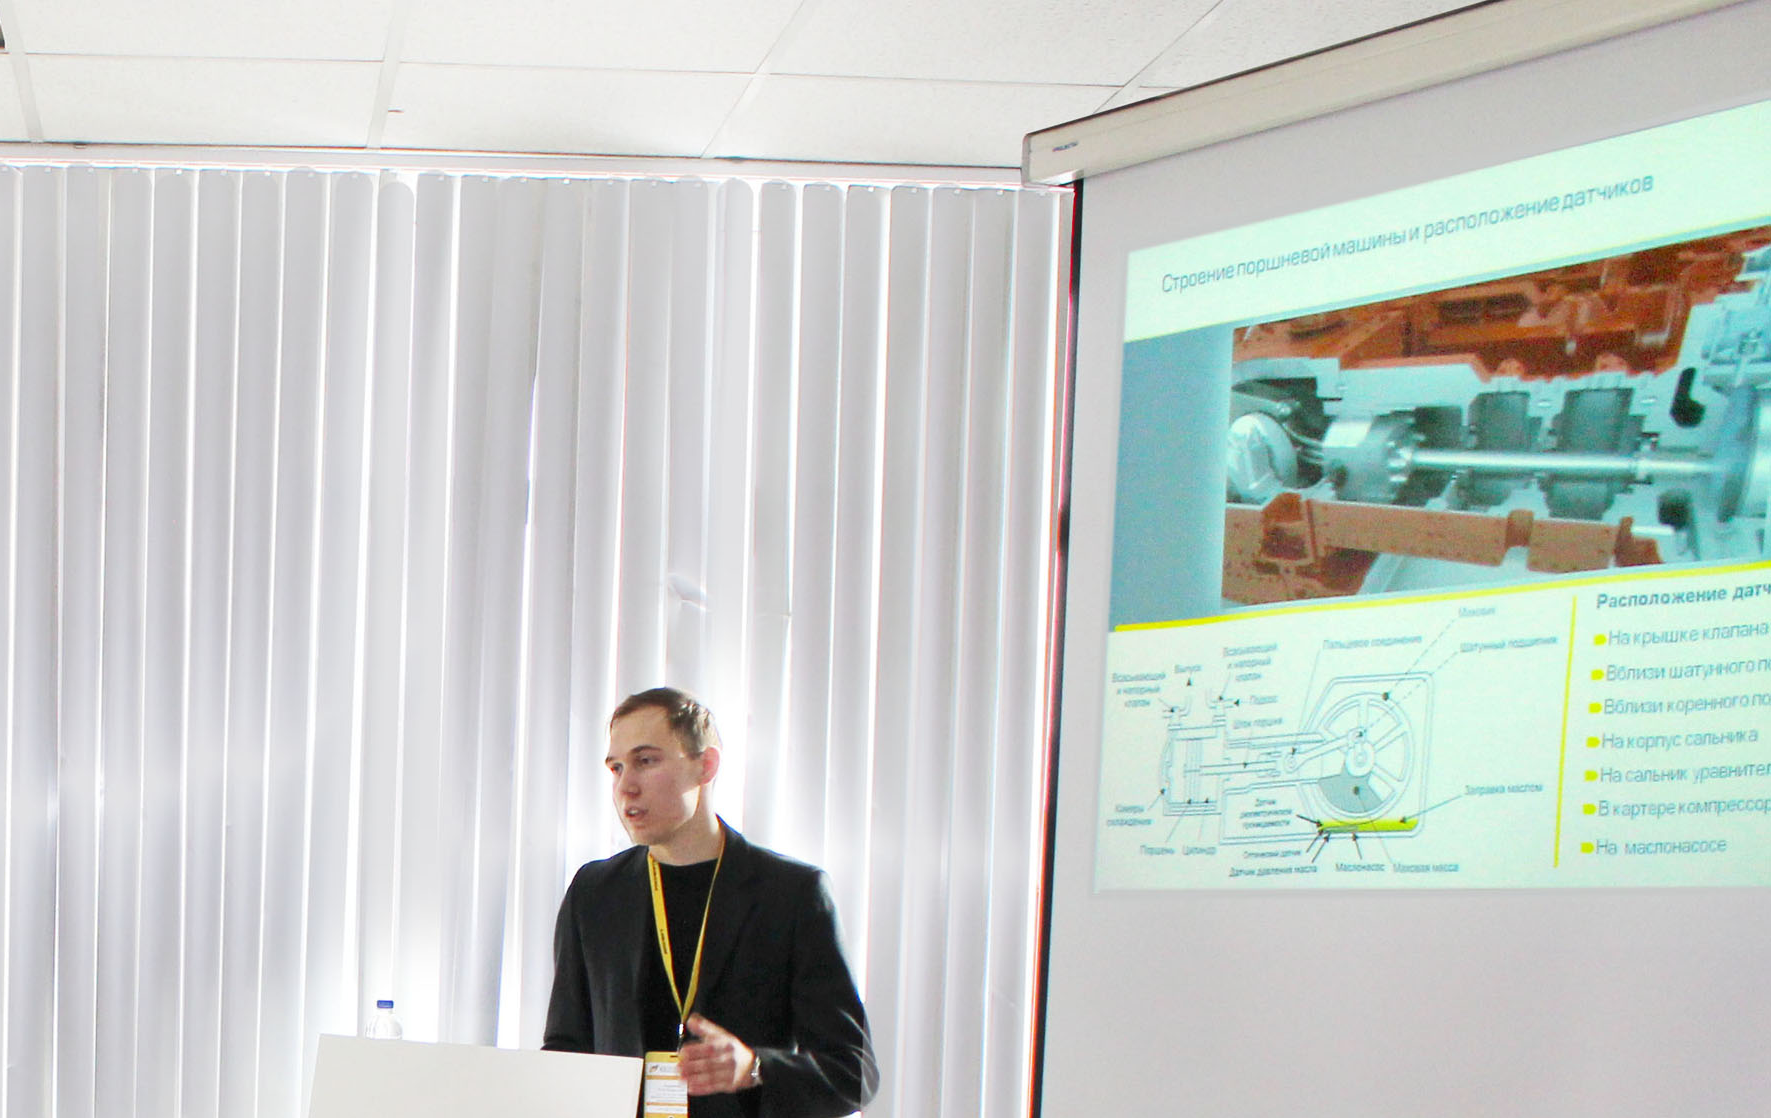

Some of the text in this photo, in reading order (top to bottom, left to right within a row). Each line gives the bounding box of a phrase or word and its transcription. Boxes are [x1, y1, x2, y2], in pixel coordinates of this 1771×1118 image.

[1162, 174, 1655, 294] Строение поршневой машины и расположение датчиков
[1596, 586, 1728, 610] Расположение
[1607, 621, 1770, 648] На крышке клапана
[1605, 663, 1666, 682] Вблизи
[1669, 658, 1755, 680] шатунного
[1603, 697, 1664, 715] Вблизи
[1666, 693, 1750, 716] коренного
[1601, 728, 1759, 753] На корпус сальника
[1599, 767, 1623, 783] На
[1625, 765, 1688, 783] сальник
[1597, 799, 1611, 817] В
[1612, 799, 1677, 819] картере
[1594, 837, 1728, 856] На маслонасосе
